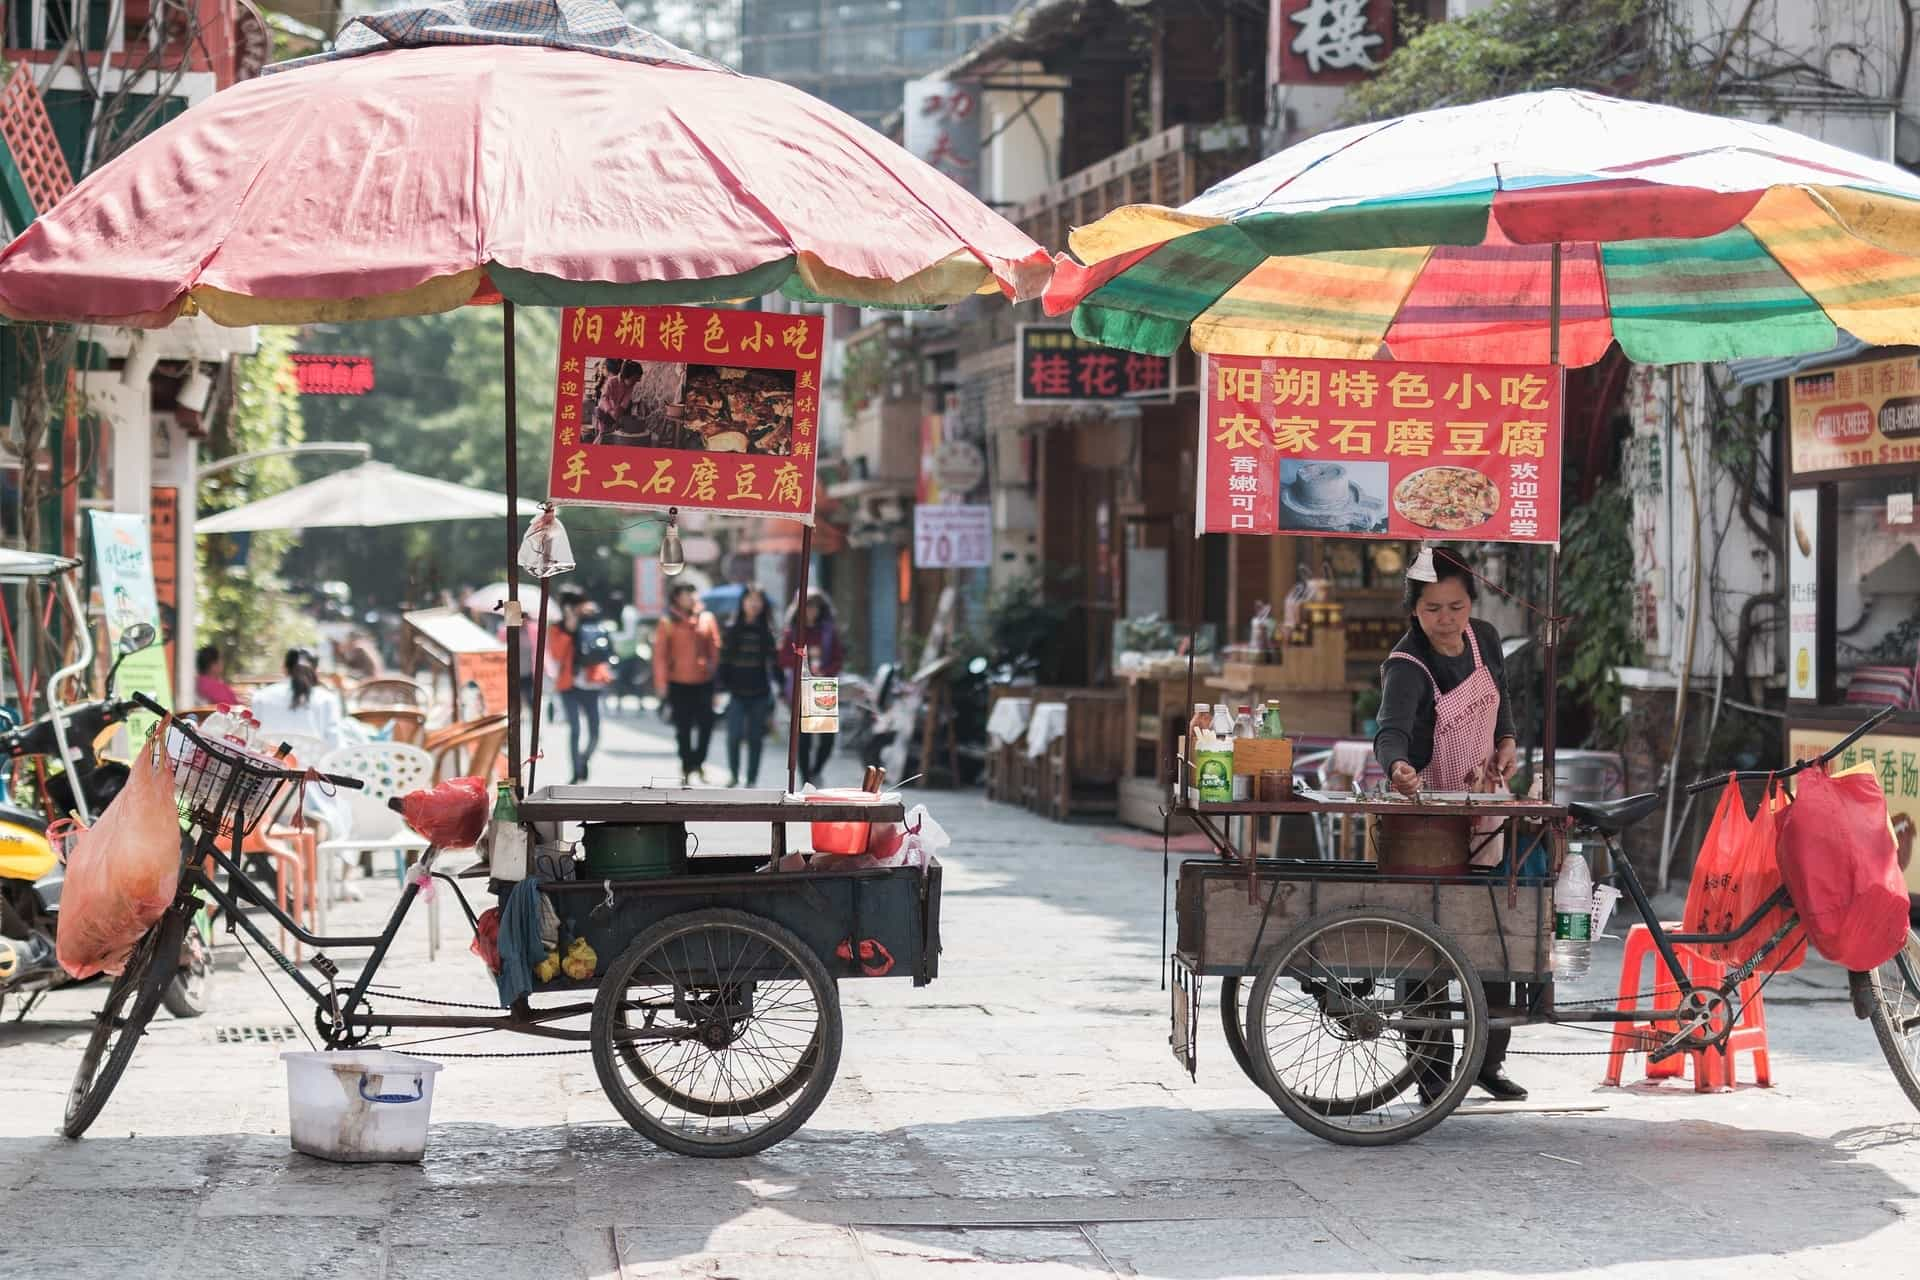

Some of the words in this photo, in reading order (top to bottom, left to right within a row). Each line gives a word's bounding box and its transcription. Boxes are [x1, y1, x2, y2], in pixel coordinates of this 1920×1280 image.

[572, 307, 817, 360] 阳朔特色小吃
[559, 357, 579, 447] 欢迎品尝
[793, 370, 816, 464] 美味香鲜
[1216, 366, 1550, 410] 阳朔特色小吃
[1214, 414, 1548, 458] 农家石磨豆腐
[562, 450, 804, 509] 手工石磨豆腐
[1228, 456, 1258, 529] 香嫩可口
[1509, 462, 1539, 537] 欢迎品尝
